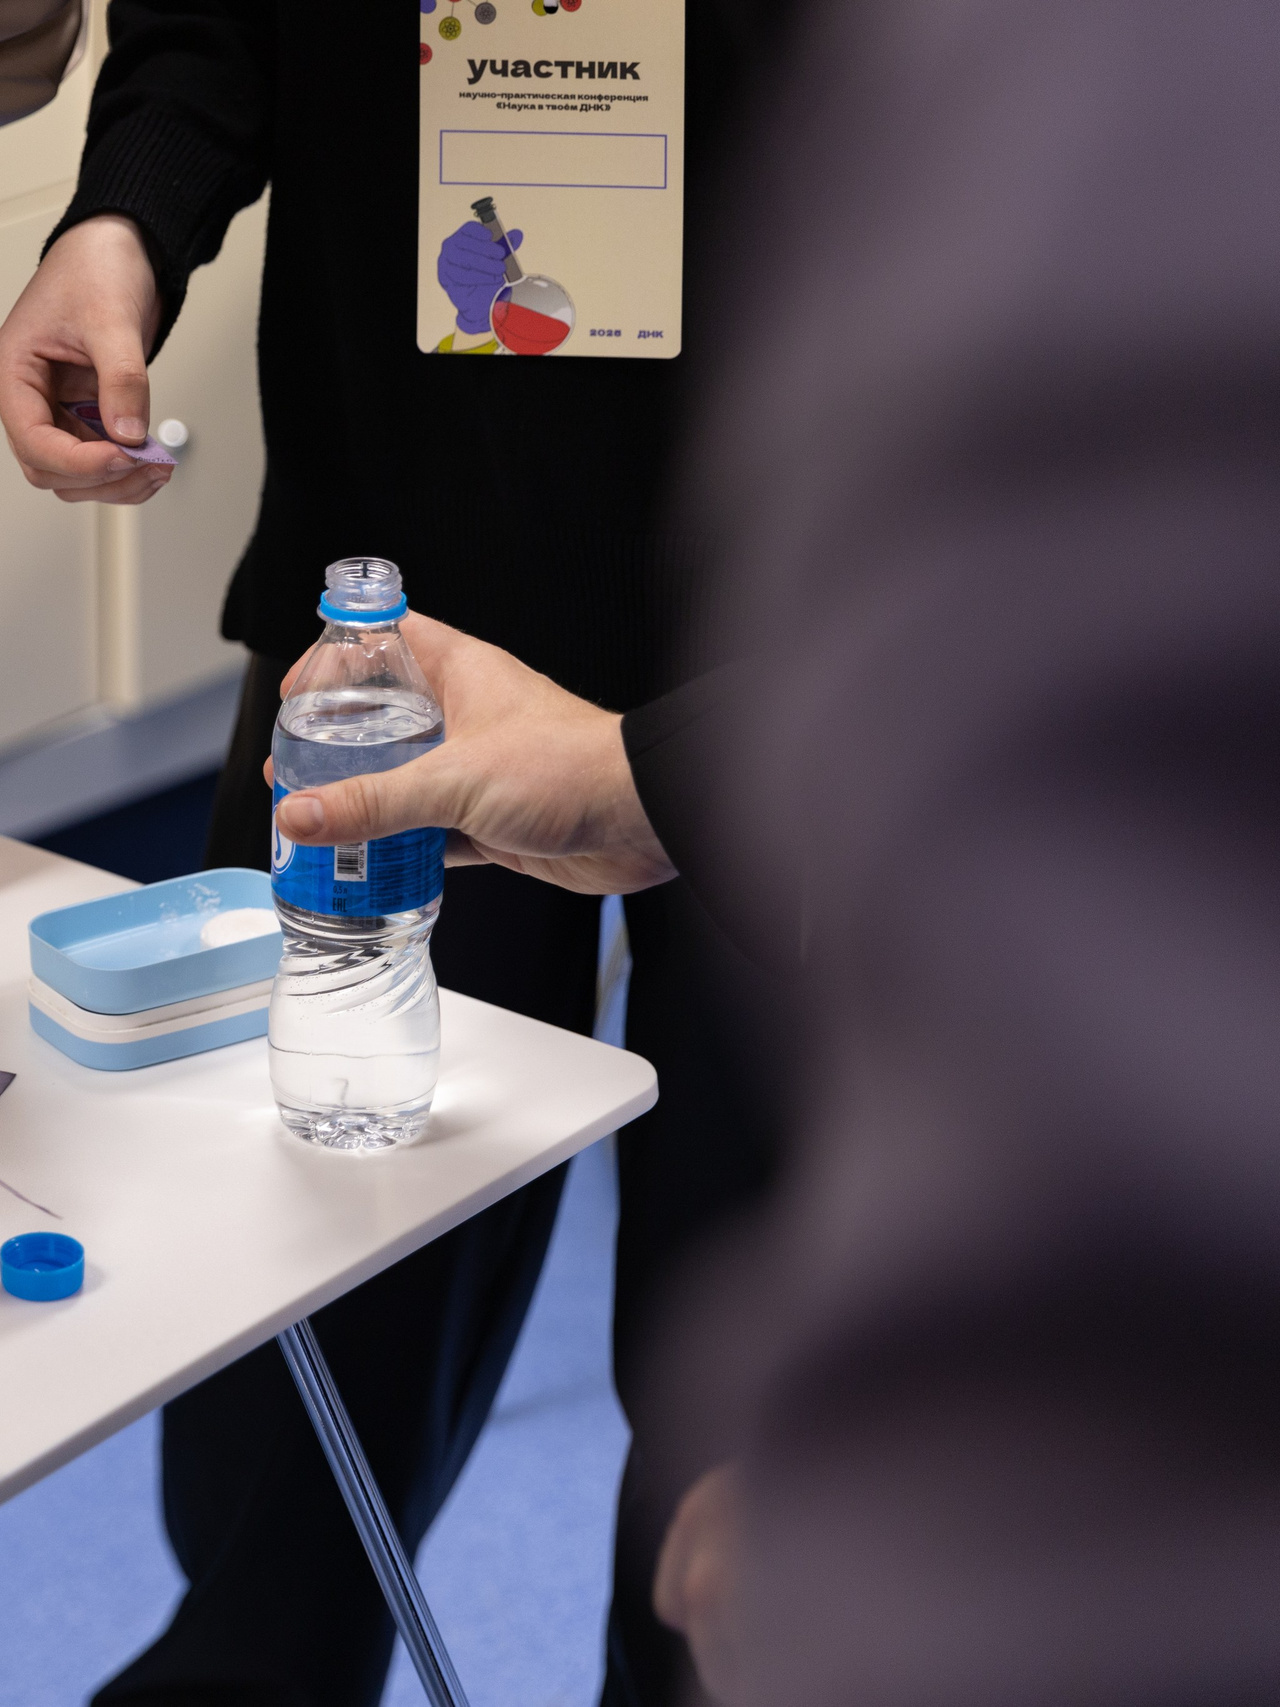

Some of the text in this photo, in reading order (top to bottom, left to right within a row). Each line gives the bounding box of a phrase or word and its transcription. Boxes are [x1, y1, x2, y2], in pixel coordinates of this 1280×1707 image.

[467, 59, 641, 85] участник
[459, 91, 649, 103] научно-практическая конференция
[496, 102, 536, 111] «Наука
[579, 104, 611, 112] ДНК»
[637, 330, 664, 339] ДНК
